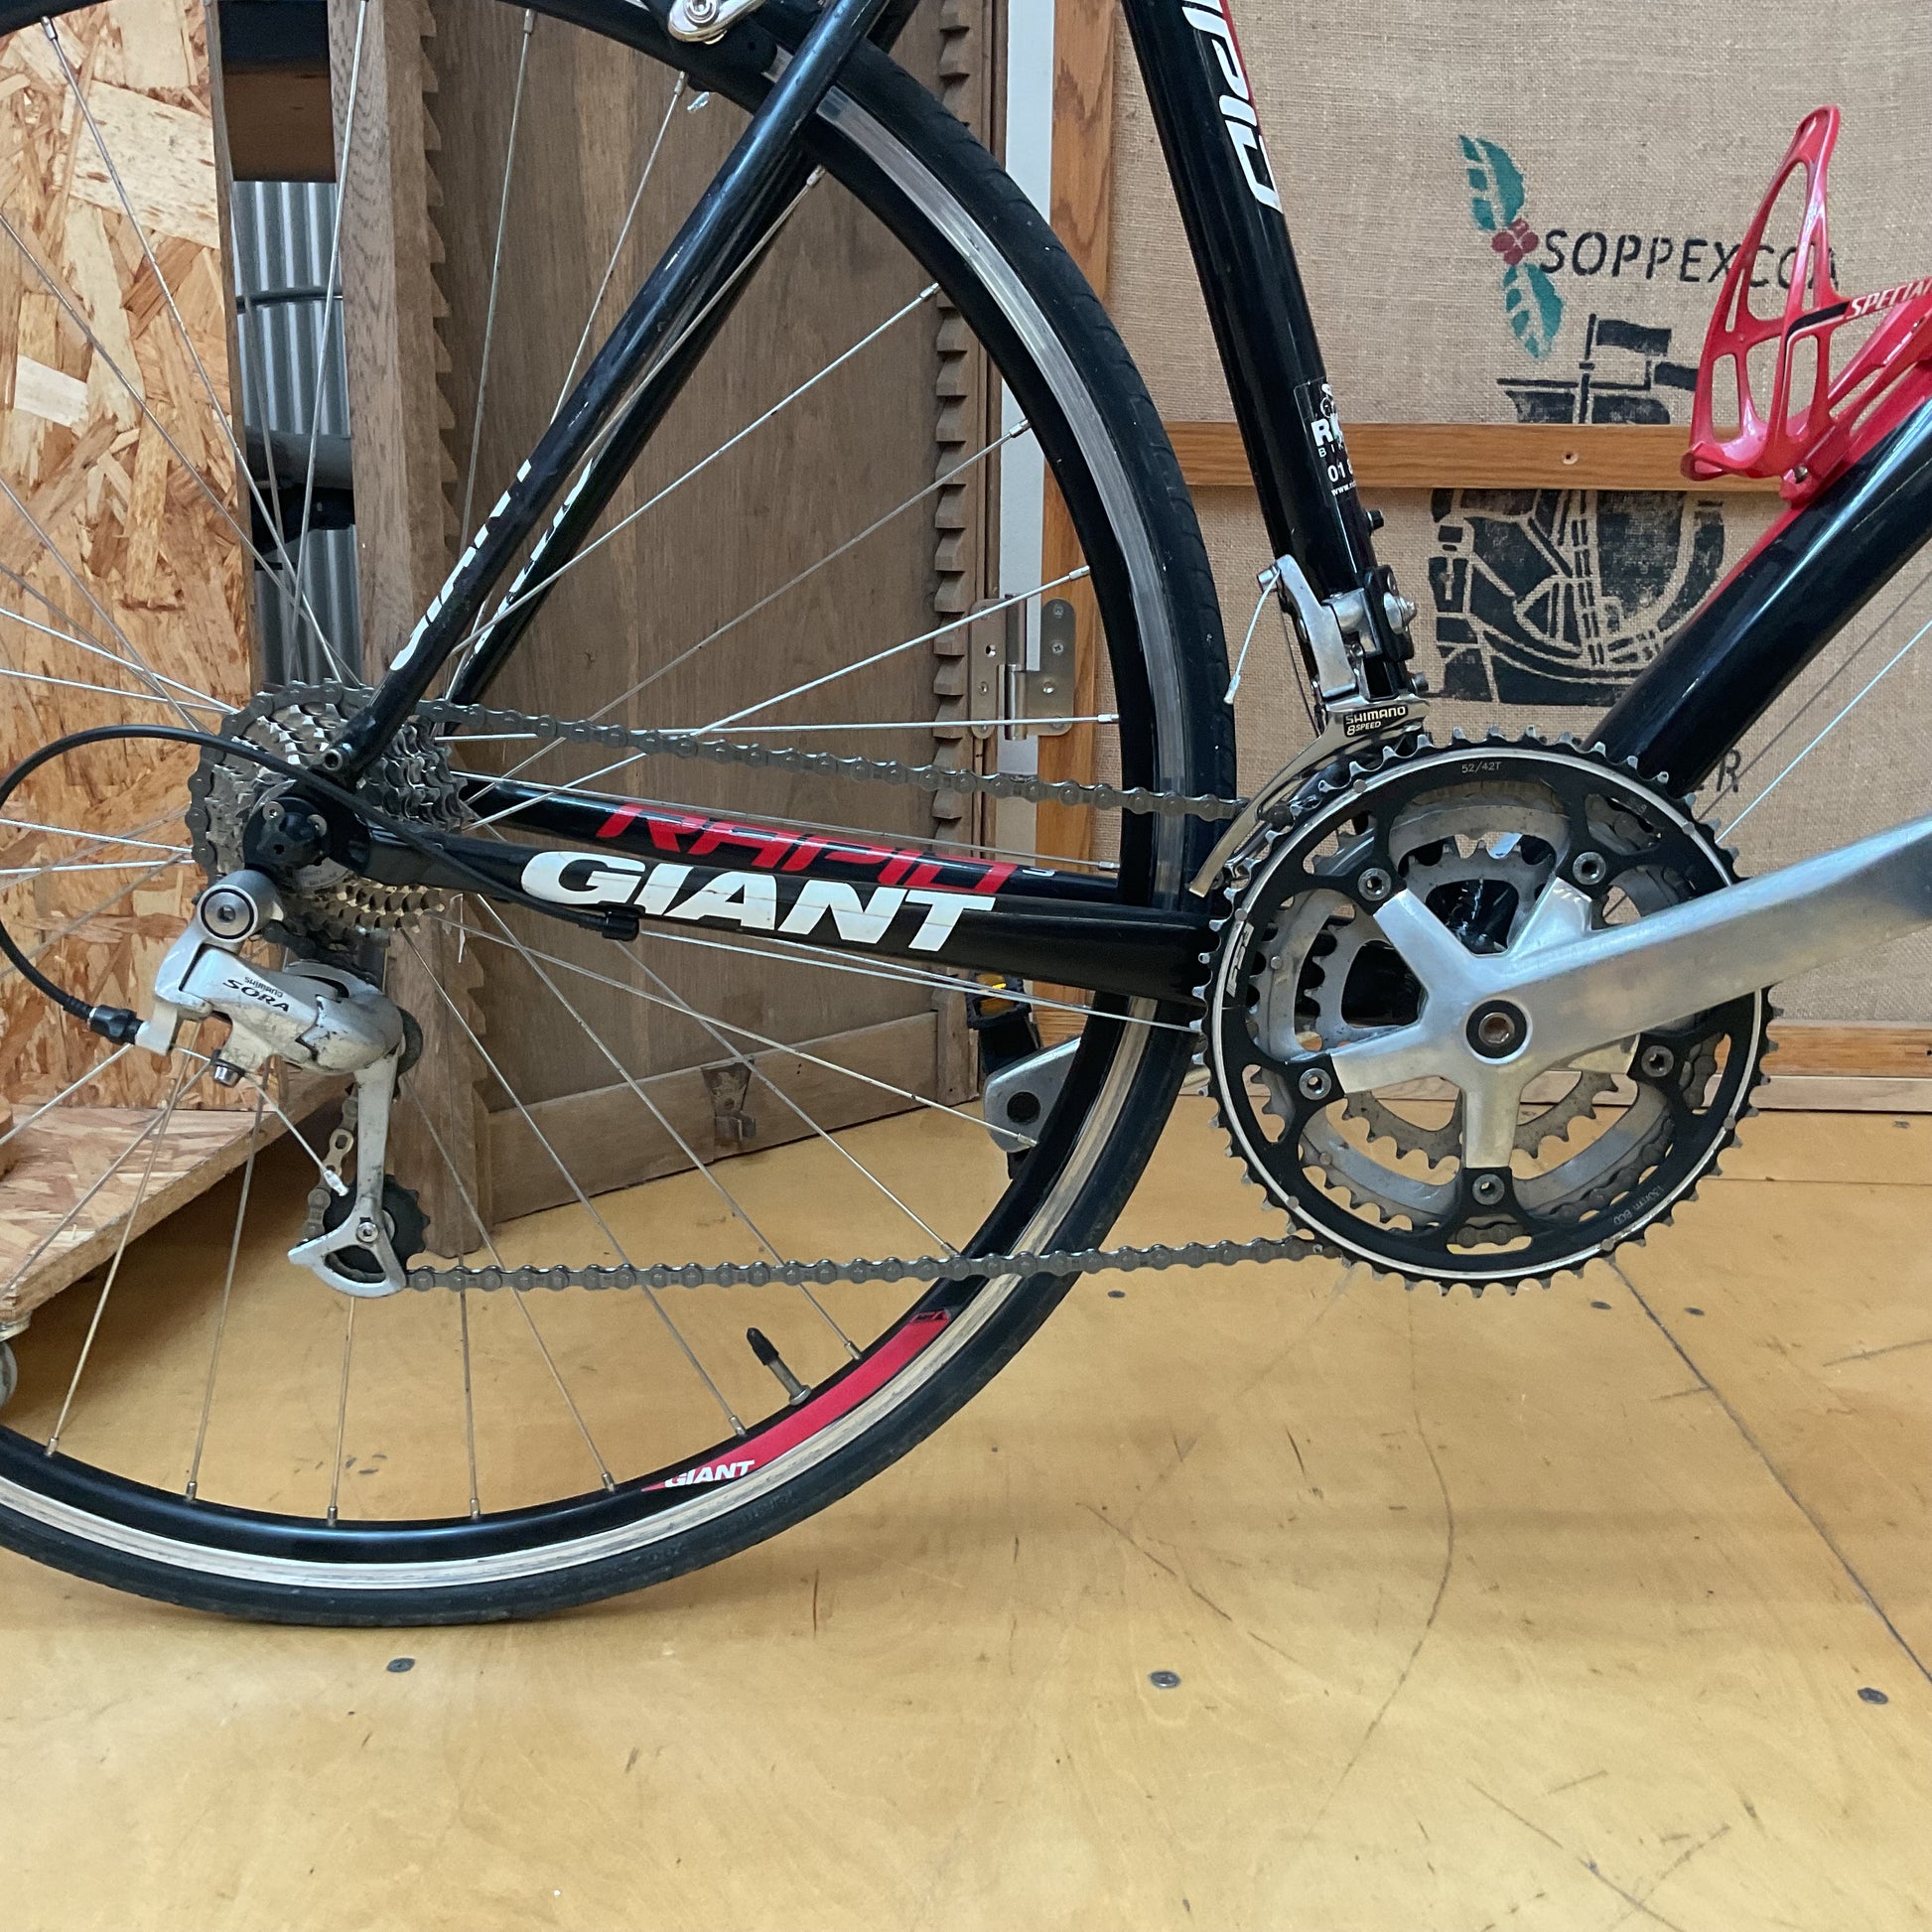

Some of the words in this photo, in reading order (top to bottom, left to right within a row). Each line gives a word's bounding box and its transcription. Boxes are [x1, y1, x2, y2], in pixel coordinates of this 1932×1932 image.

[1181, 0, 1284, 215] PID
[1327, 462, 1346, 483] 01
[1345, 706, 1407, 725] SHIMANO
[1460, 760, 1502, 773] 52/42T
[596, 802, 1017, 894] RAPID
[520, 851, 995, 952] GIANT
[222, 979, 290, 1013] SORA
[244, 976, 284, 998] SHIMANO
[664, 1458, 756, 1488] GIANT
